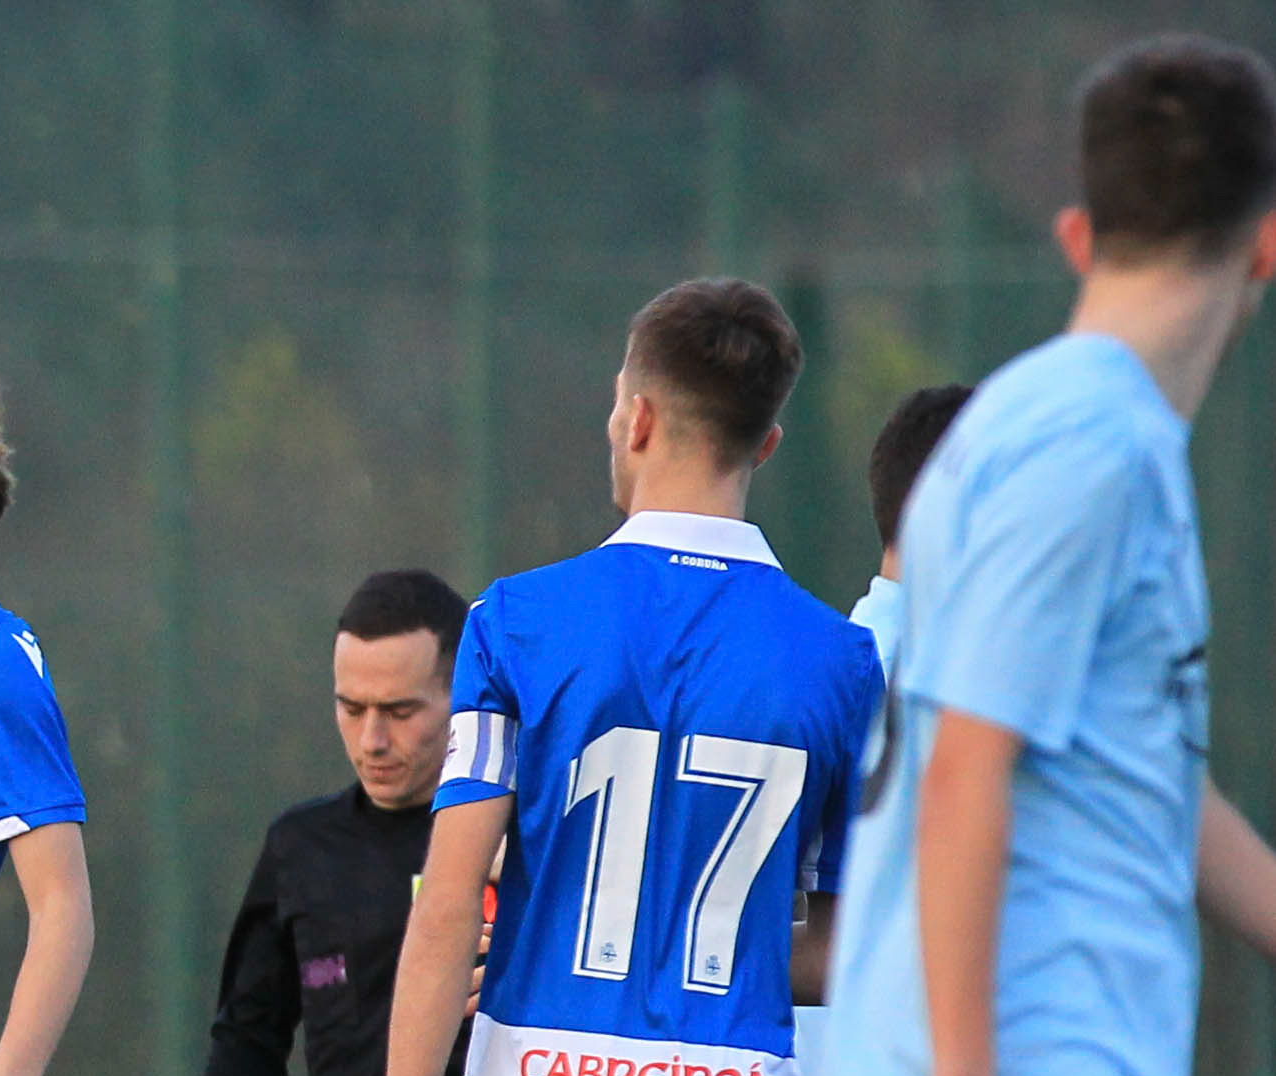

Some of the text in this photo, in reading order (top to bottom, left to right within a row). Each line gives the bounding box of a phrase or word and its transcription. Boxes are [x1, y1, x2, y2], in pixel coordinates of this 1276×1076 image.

[669, 554, 729, 571] A CORUÑA
[564, 726, 808, 996] 17
